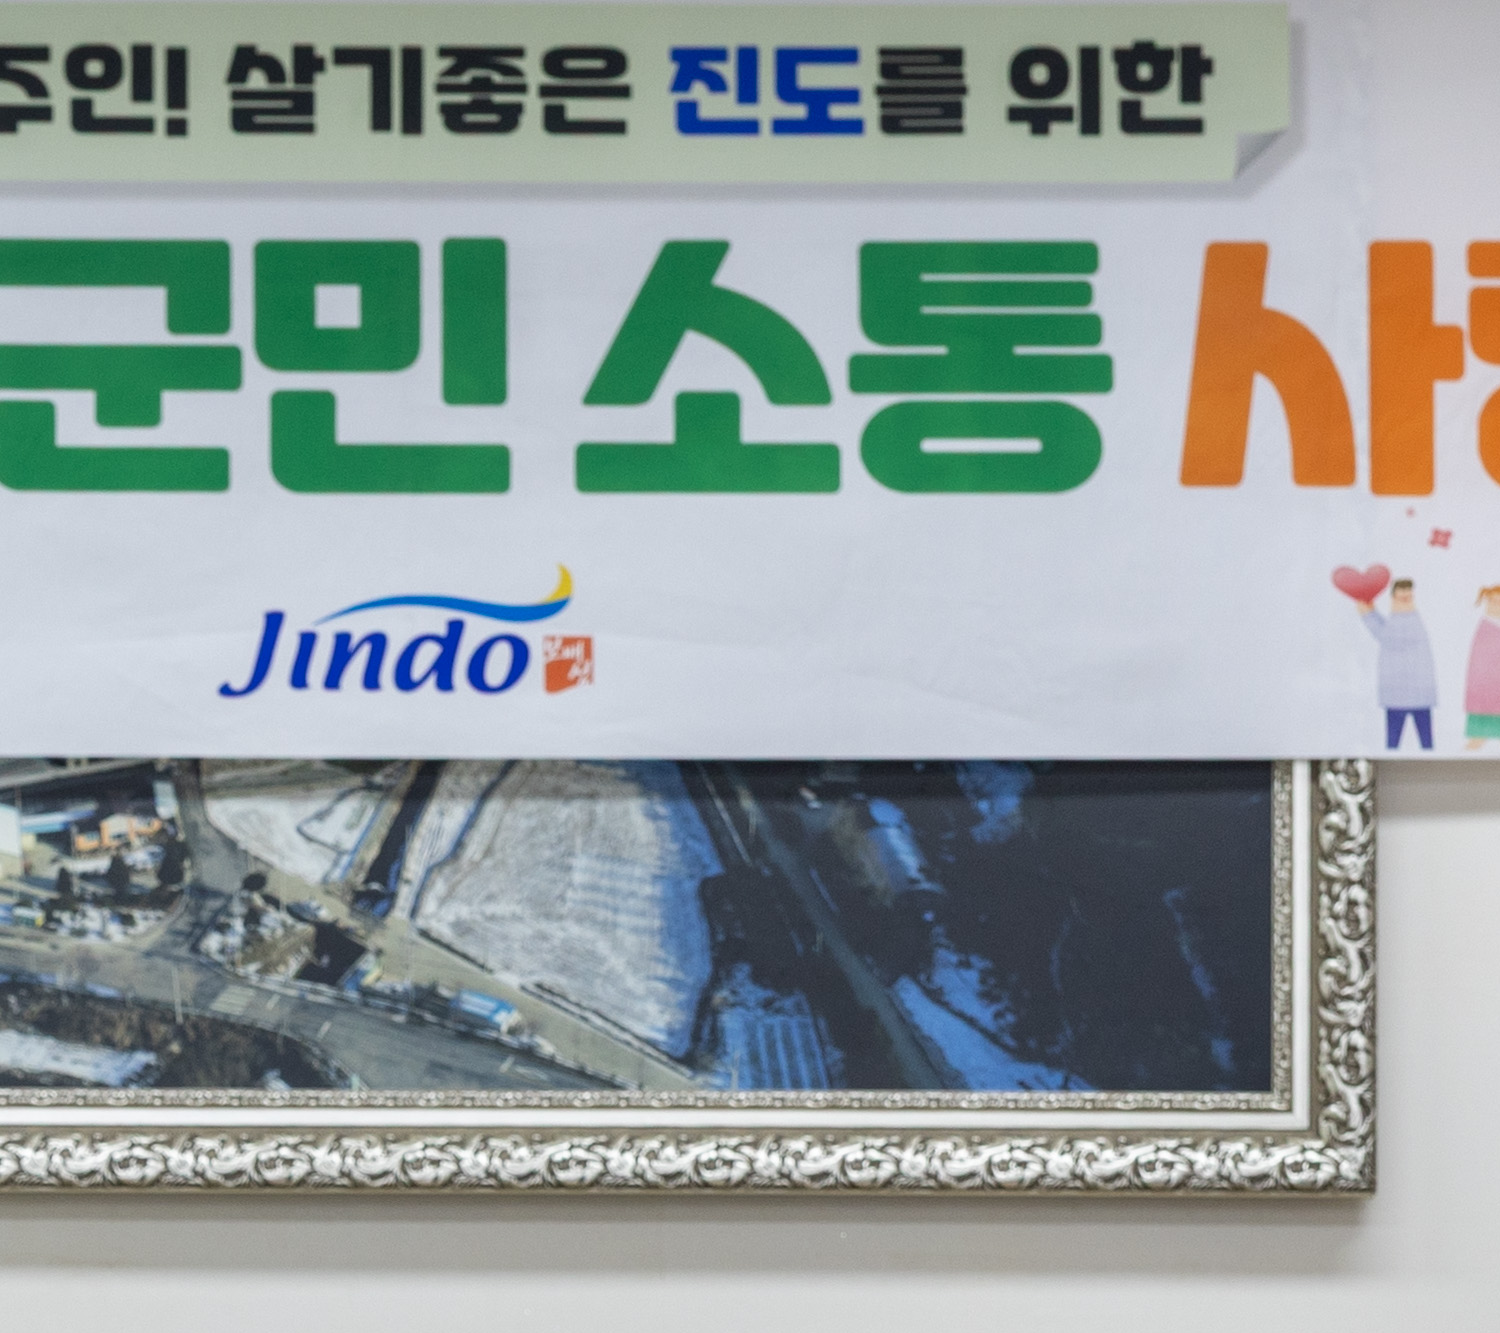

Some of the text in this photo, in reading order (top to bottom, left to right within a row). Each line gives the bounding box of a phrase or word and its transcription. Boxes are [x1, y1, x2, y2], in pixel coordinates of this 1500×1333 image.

[226, 44, 632, 136] 살기좋은
[670, 45, 968, 137] 진도를
[1006, 40, 1216, 136] 위한
[574, 238, 1115, 497] 소통
[217, 609, 531, 698] Jindo
